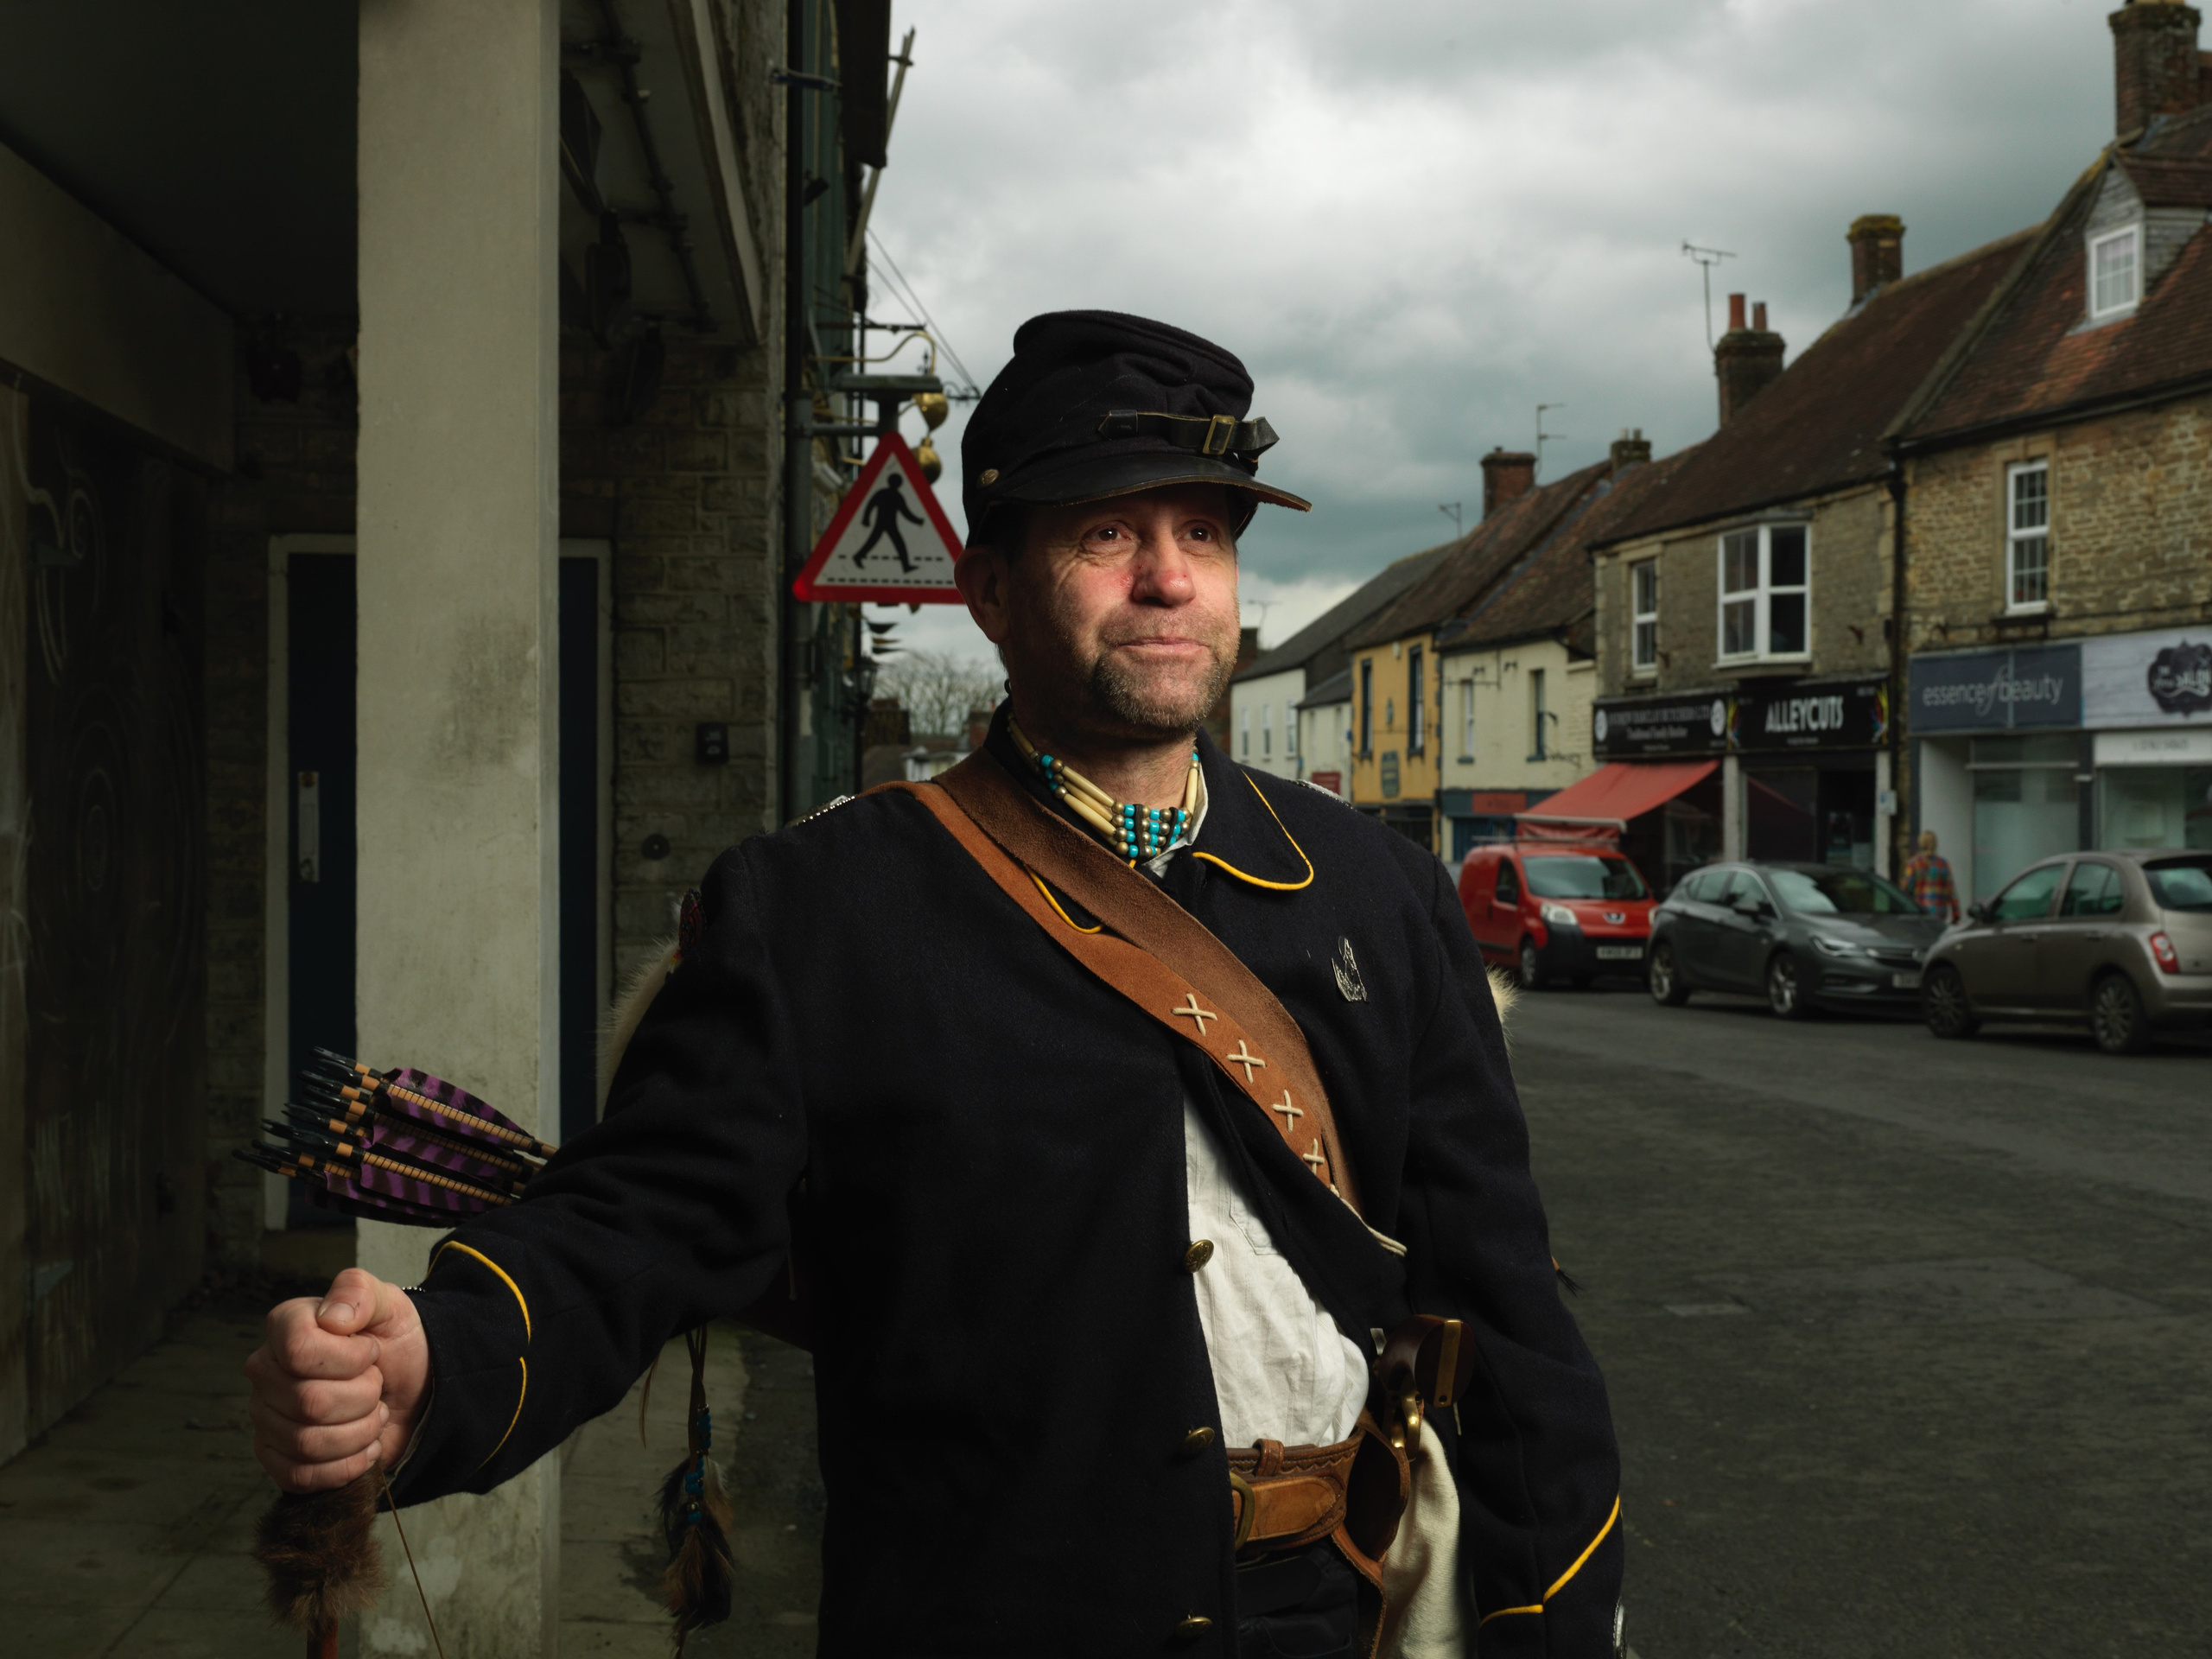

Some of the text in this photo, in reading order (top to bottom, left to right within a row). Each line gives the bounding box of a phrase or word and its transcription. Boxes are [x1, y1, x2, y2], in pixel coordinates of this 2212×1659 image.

[1922, 683, 1986, 707] essence
[1998, 672, 2064, 706] beauty
[1764, 695, 1844, 733] ALLEYCUTS
